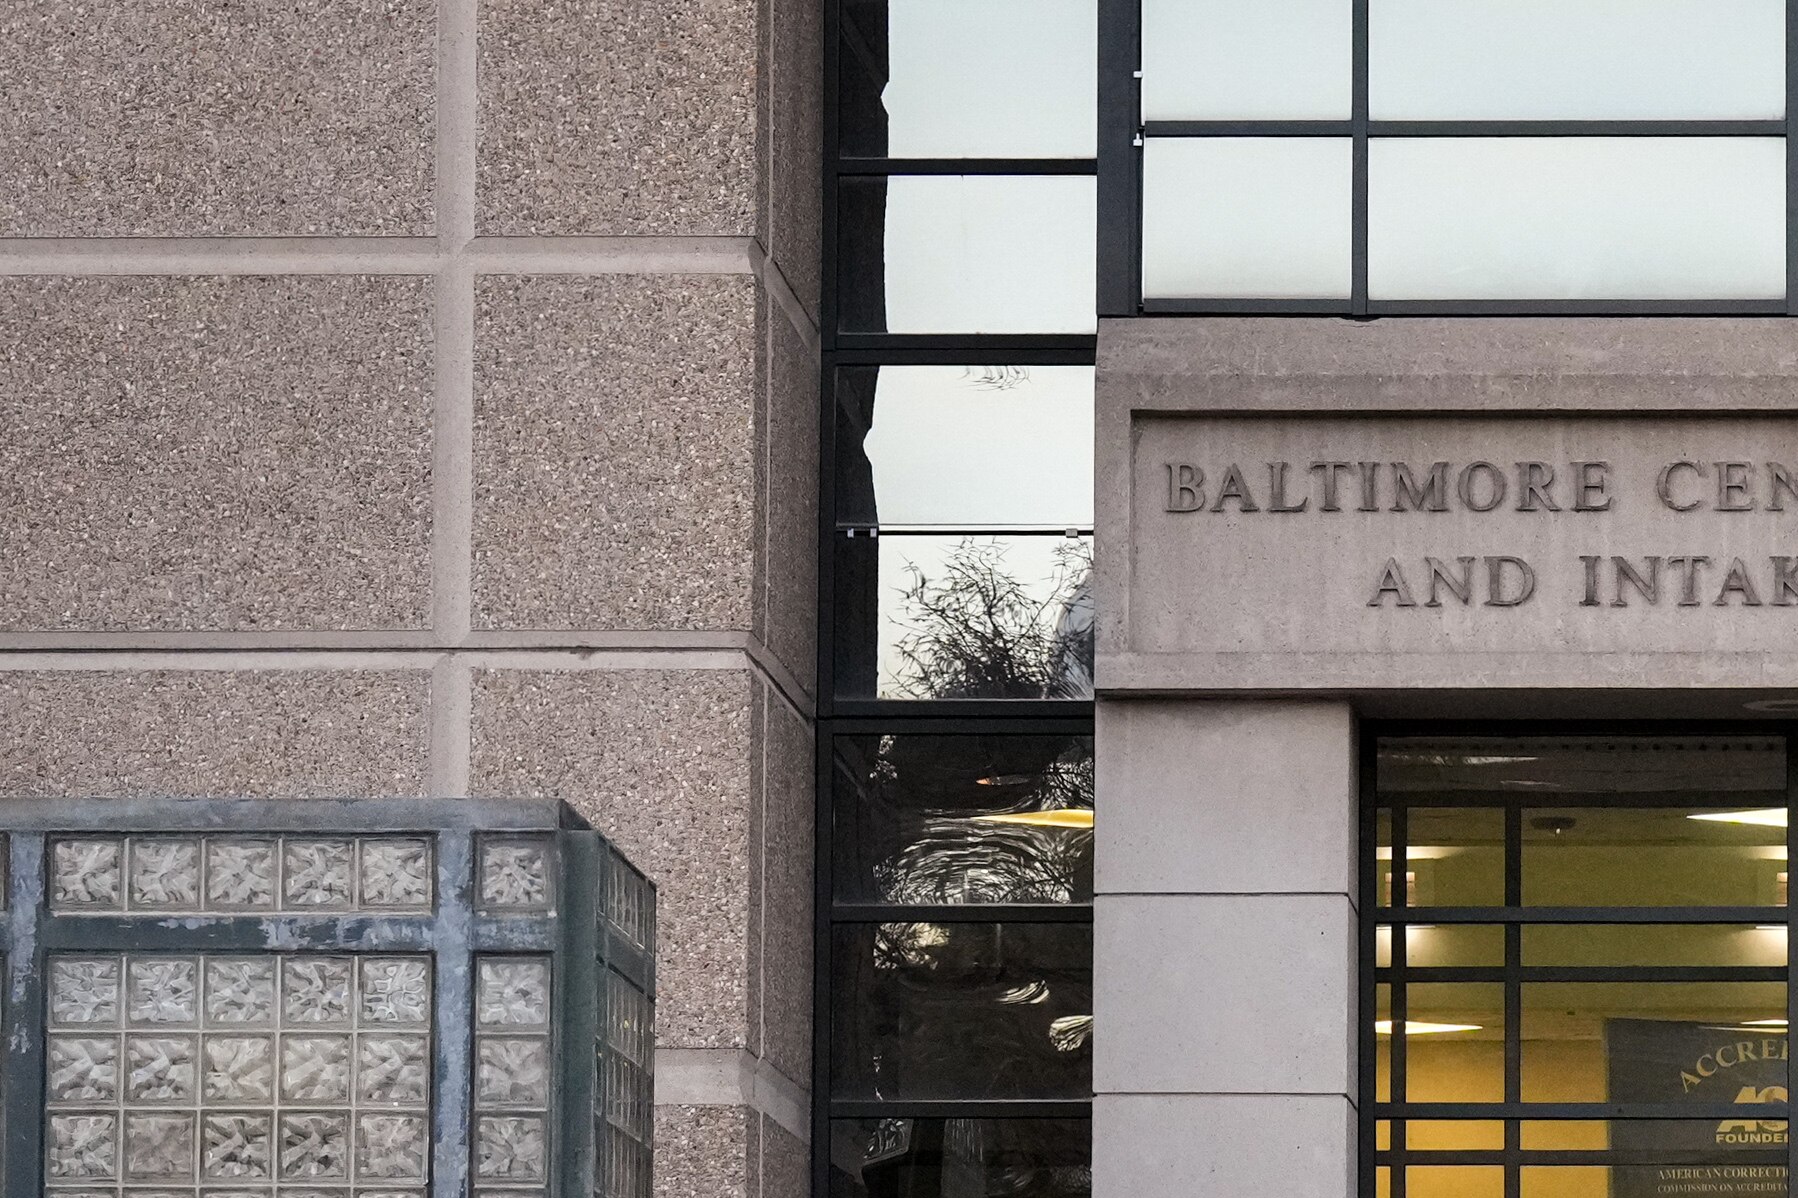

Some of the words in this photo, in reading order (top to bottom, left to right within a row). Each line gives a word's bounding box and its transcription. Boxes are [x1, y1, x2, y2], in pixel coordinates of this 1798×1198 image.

[1165, 458, 1613, 516] BALTIMORE
[1367, 554, 1538, 609] AND
[1716, 1133, 1790, 1143] FOUNDE
[1659, 1167, 1722, 1180] AMERICAN
[1657, 1183, 1718, 1193] COMMISSION
[1719, 1182, 1734, 1192] ON
